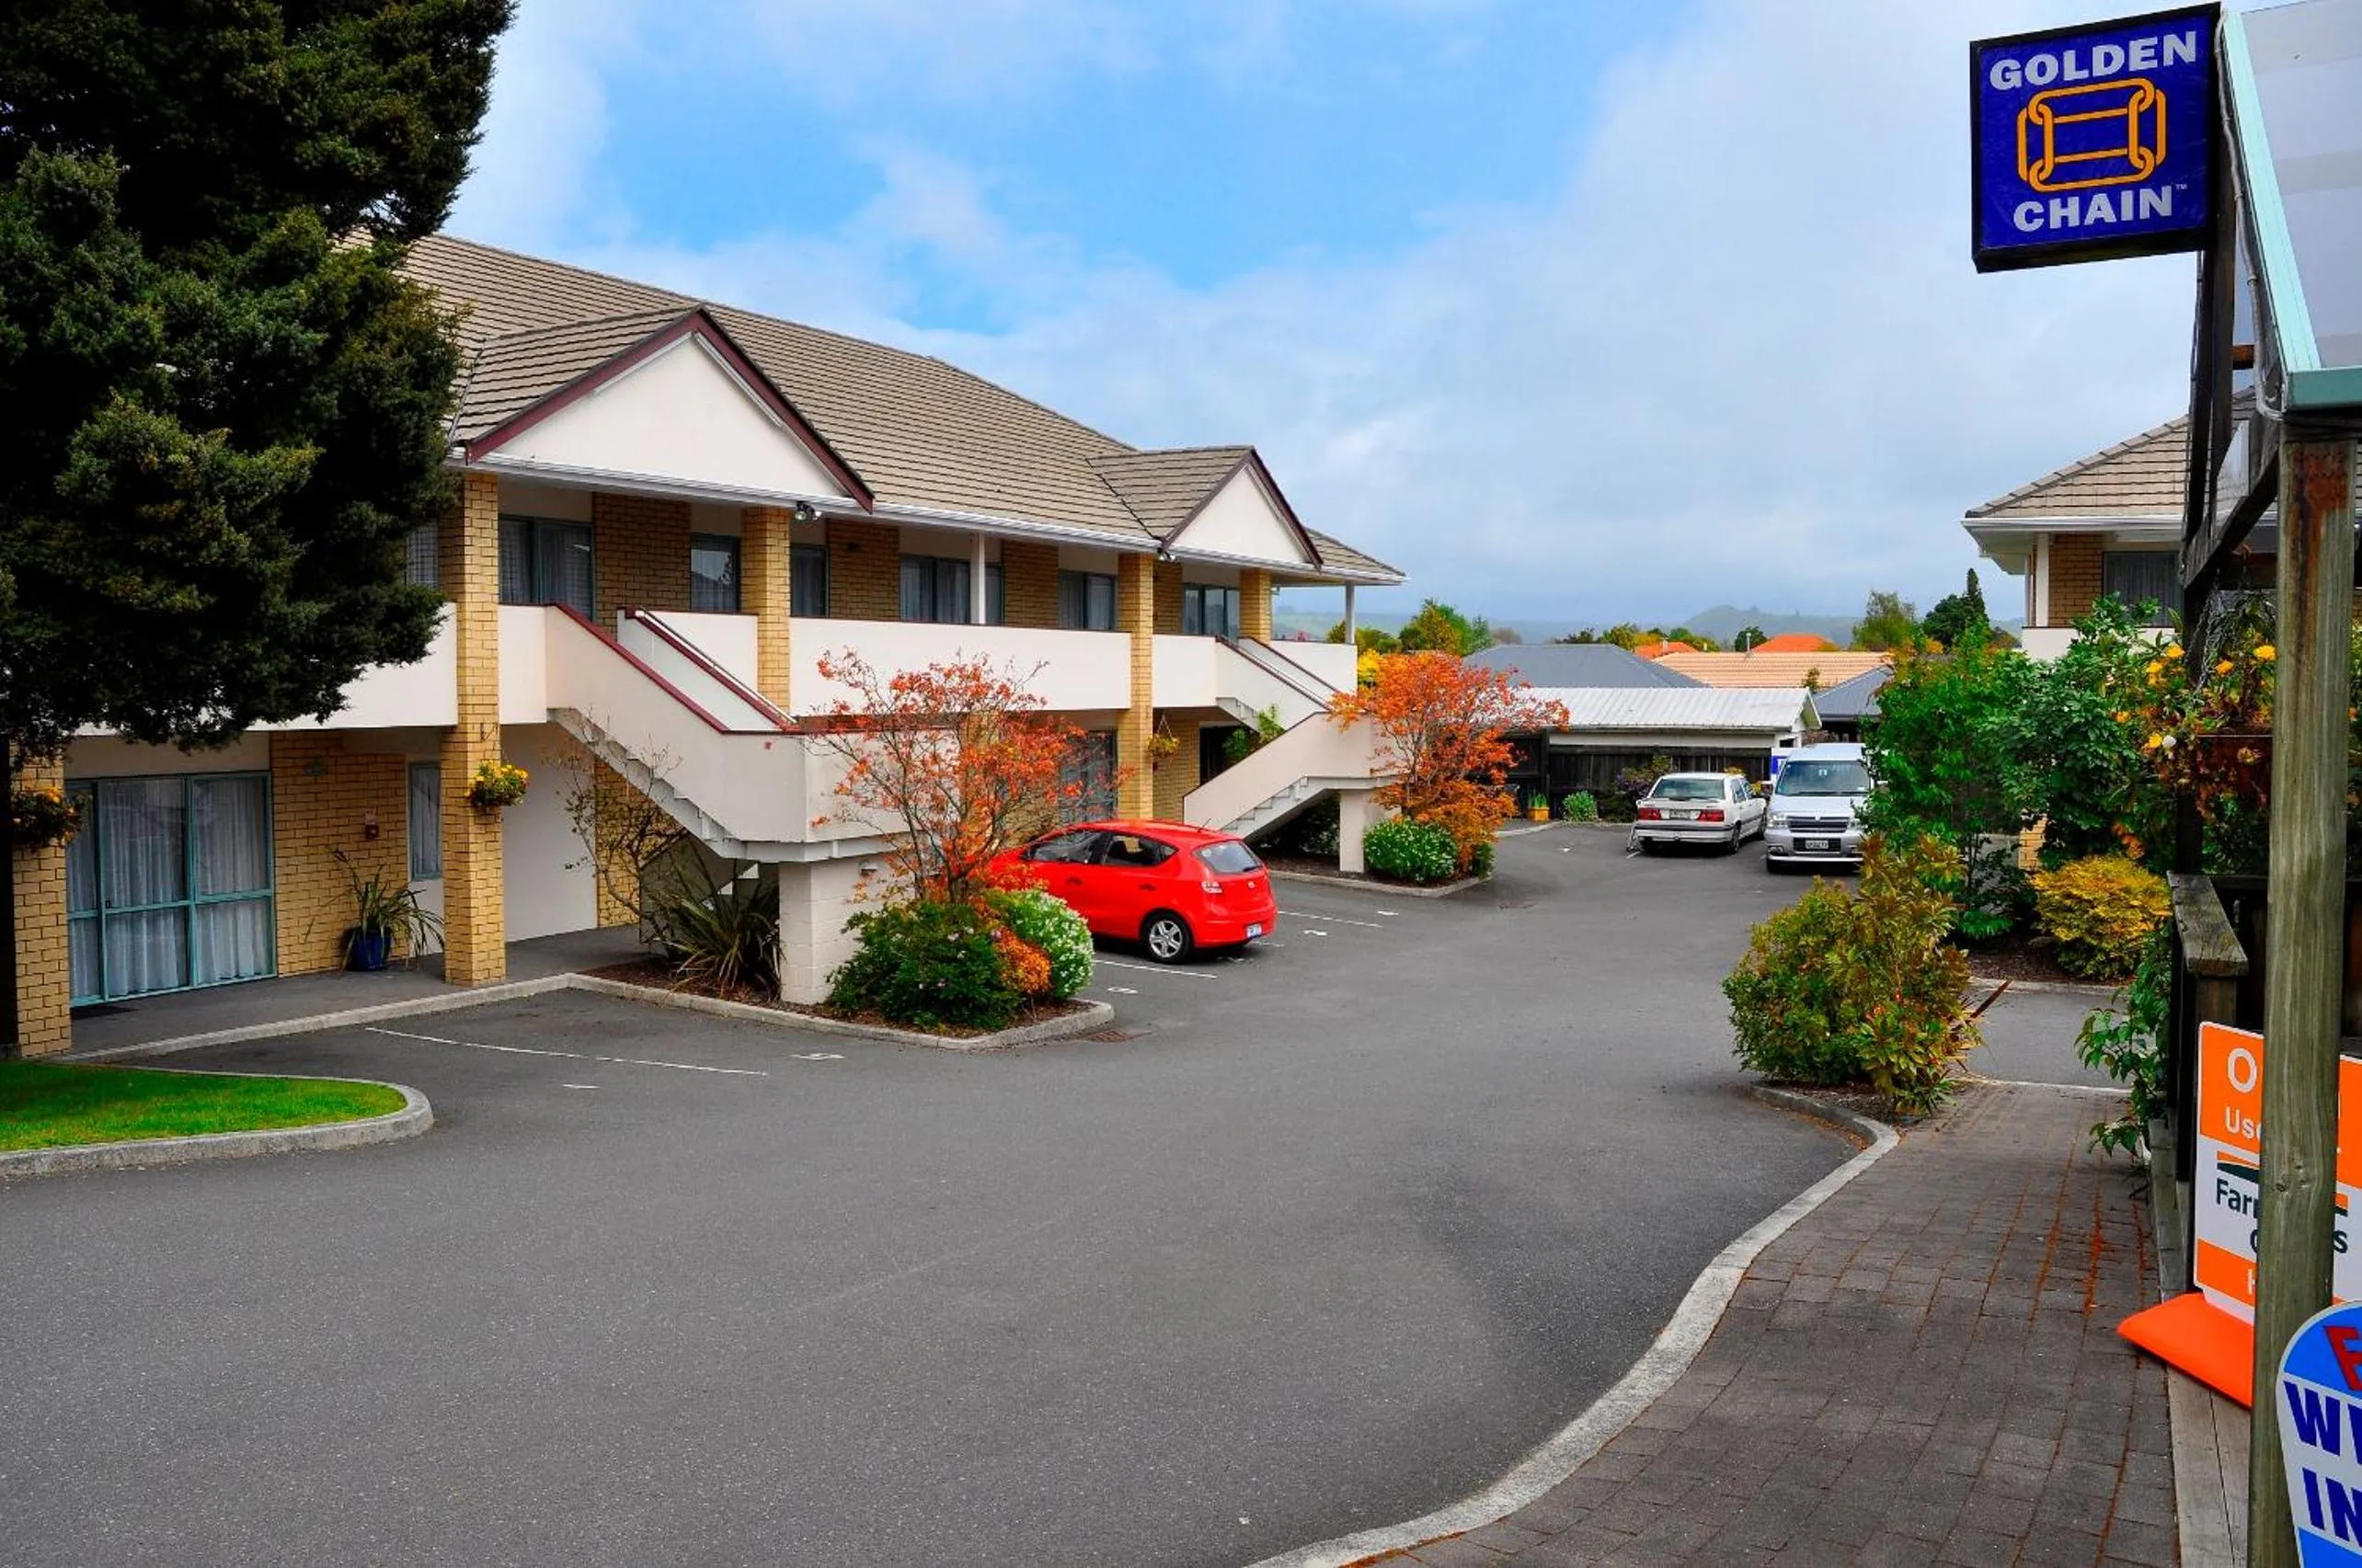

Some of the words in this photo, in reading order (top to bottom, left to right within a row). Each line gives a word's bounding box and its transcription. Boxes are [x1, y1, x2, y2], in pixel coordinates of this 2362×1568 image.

[1989, 31, 2196, 90] GOLDEN
[2013, 186, 2173, 232] CHAIN
[2227, 1047, 2257, 1093] O
